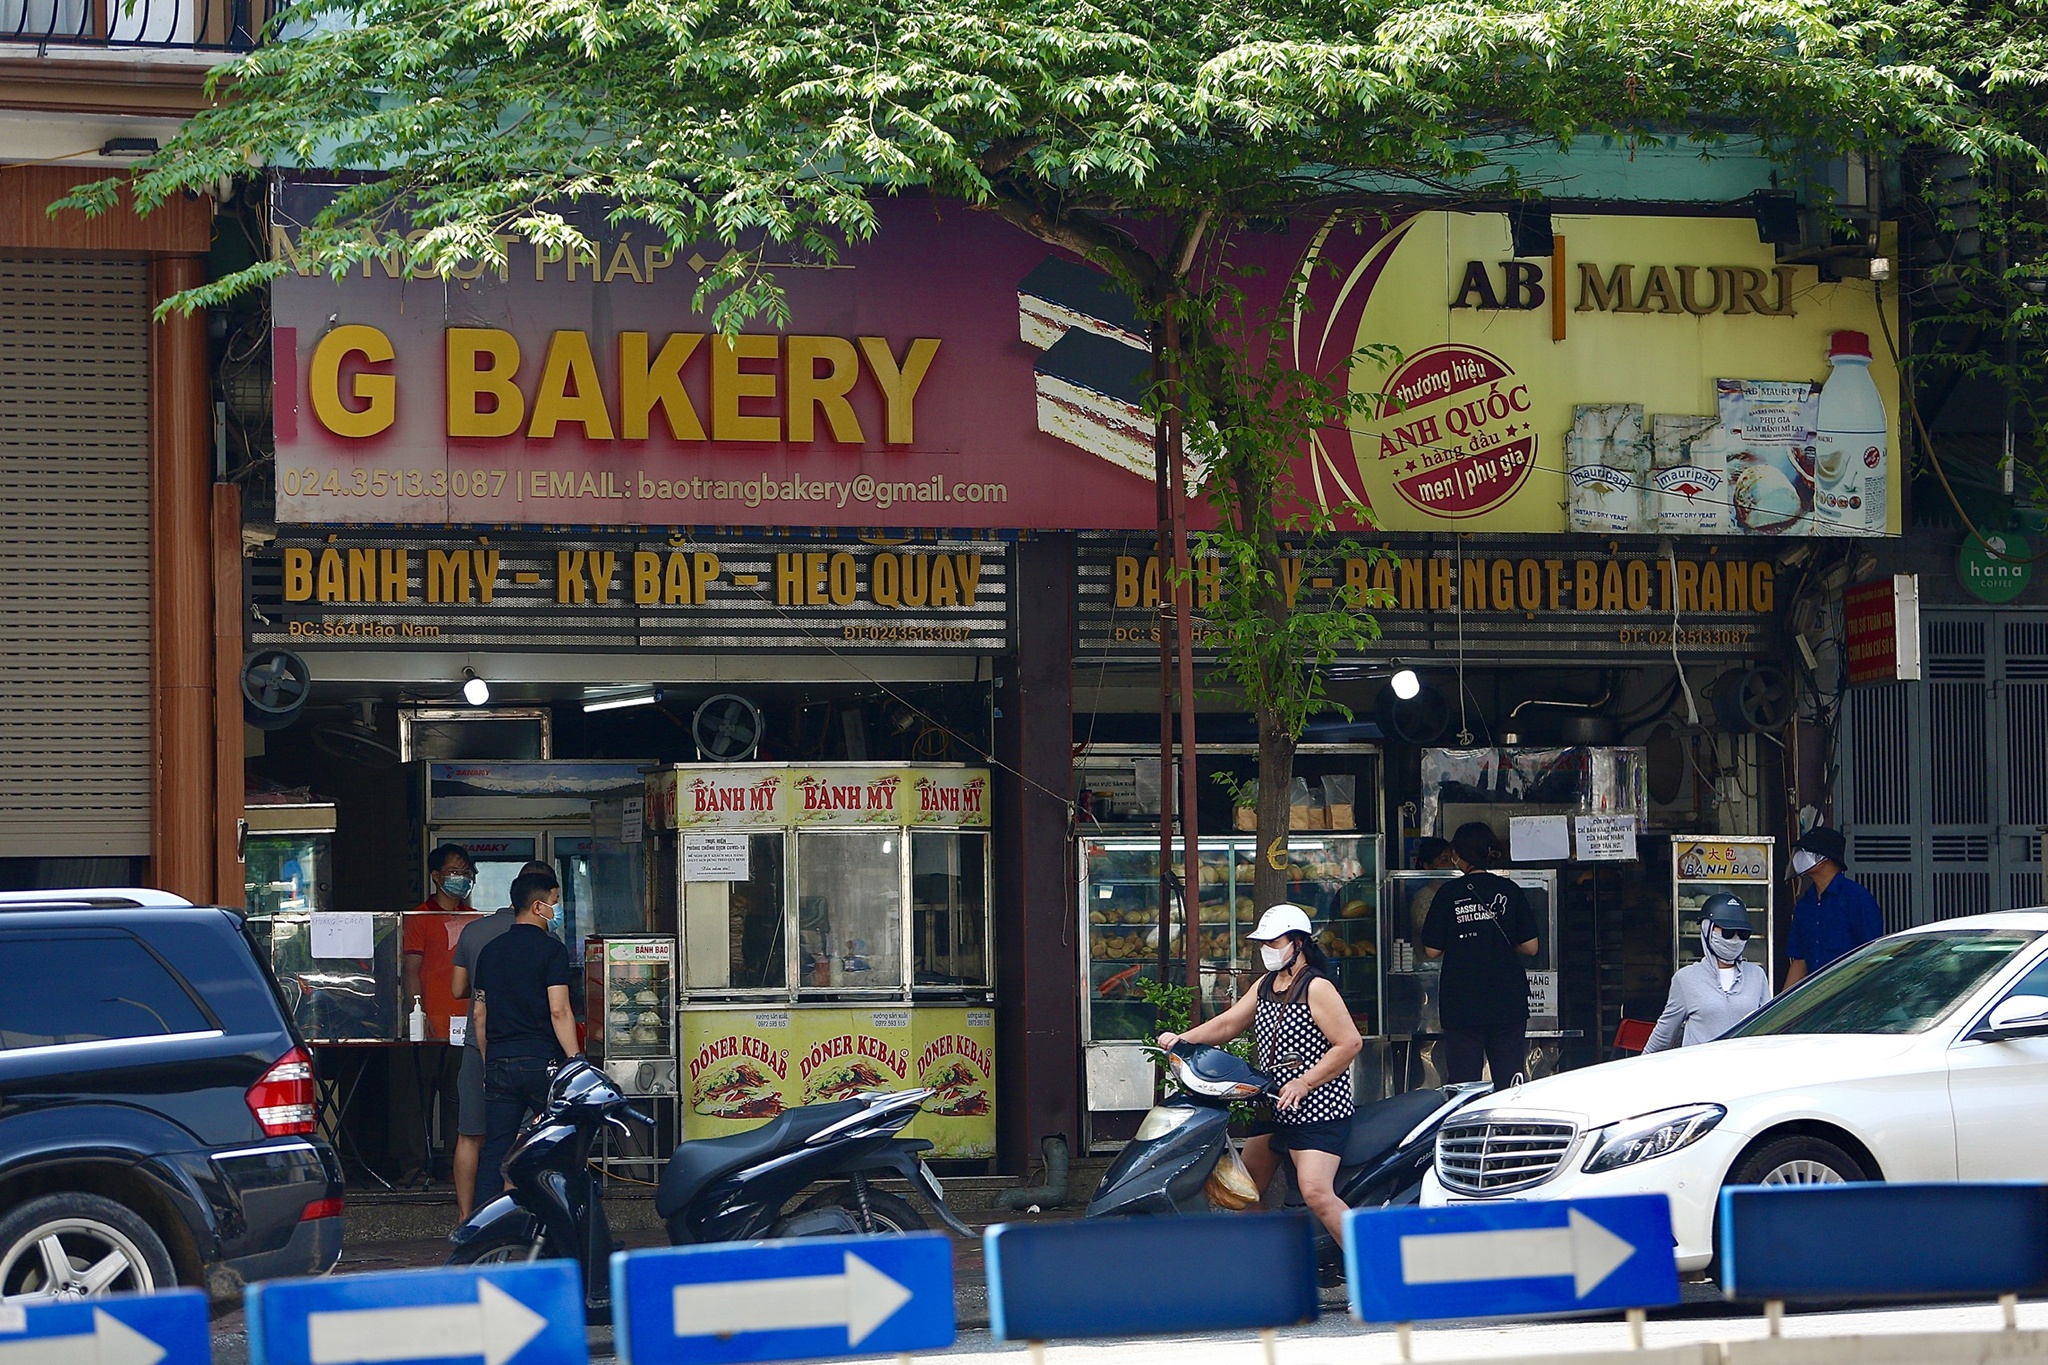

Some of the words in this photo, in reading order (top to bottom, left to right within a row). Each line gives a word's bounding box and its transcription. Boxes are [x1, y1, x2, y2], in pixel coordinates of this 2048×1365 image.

[535, 232, 674, 284] PHÁP
[1450, 260, 1546, 310] AB
[1574, 263, 1799, 317] MAURI
[309, 324, 397, 439] G
[446, 326, 942, 445] BAKERY
[1396, 368, 1450, 403] thương
[1451, 358, 1487, 384] hiệu
[1761, 388, 1790, 396] MAURI
[1378, 415, 1442, 461] ANH
[1445, 381, 1532, 438] QUỐC
[1421, 444, 1465, 468] hàng
[1469, 430, 1501, 452] đầu
[283, 467, 508, 498] 024.3513.3087
[530, 471, 633, 498] EMAIL:
[637, 471, 1009, 509] baotrangbakery@gmail.com
[1418, 477, 1454, 502] men
[1464, 459, 1498, 496] phụ
[1499, 447, 1526, 477] gia
[1574, 468, 1628, 488] mauripan
[1660, 468, 1716, 487] mauripan
[1610, 513, 1628, 521] YEAST
[283, 534, 408, 603] BÁNH
[426, 536, 500, 604] MỲ
[556, 551, 616, 605] KY
[634, 533, 720, 605] BẮP
[776, 552, 858, 607] HEO
[872, 552, 982, 609] QUAY
[1345, 542, 1452, 610] BÁNH
[1656, 545, 1775, 613] TRÁNG
[1970, 560, 2022, 577] hana
[288, 620, 321, 637] ĐC:
[401, 623, 441, 637] Nam
[1115, 627, 1146, 642] ĐC:
[1618, 630, 1644, 644] ĐT:
[455, 768, 491, 776] SANAKY
[694, 779, 746, 812] BÁNH
[803, 779, 861, 811] BÁNH
[921, 778, 960, 812] BÁNH
[1731, 864, 1761, 875] BAO
[1455, 904, 1477, 915] SASSY
[1456, 913, 1474, 924] STILL
[635, 945, 653, 954] BÁNH
[655, 945, 669, 954] BAO
[1529, 988, 1545, 1000] NHÀ
[689, 1035, 739, 1081] DÖNER
[741, 1035, 788, 1080] KEBAB
[799, 1034, 854, 1080] DÖNER
[857, 1034, 909, 1080] KEBAB
[917, 1034, 954, 1078] DÖNER
[955, 1034, 992, 1080] KEBAB
